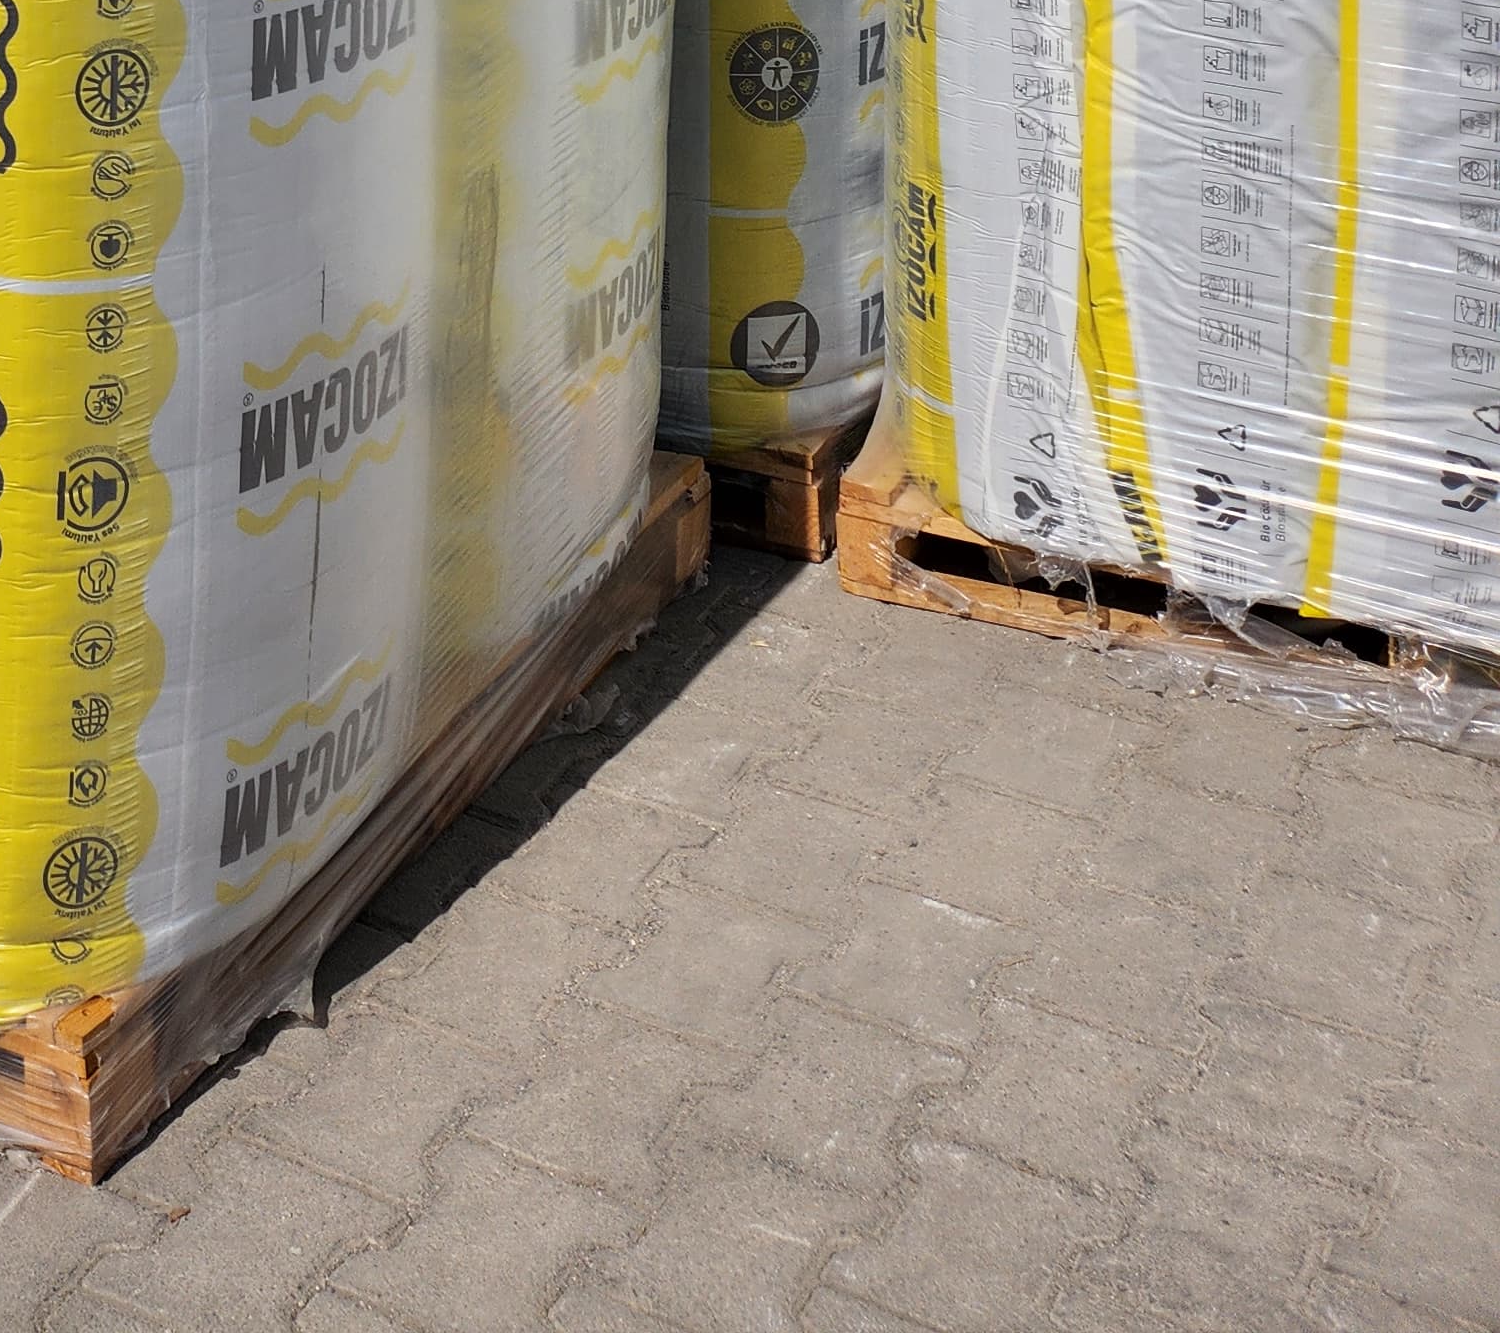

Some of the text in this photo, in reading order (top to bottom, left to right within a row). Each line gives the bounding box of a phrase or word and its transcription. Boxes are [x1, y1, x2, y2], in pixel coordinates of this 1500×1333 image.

[89, 123, 128, 137] Yalıtımı
[62, 522, 119, 543] Ses Yalıtımı
[1261, 525, 1270, 542] Bio
